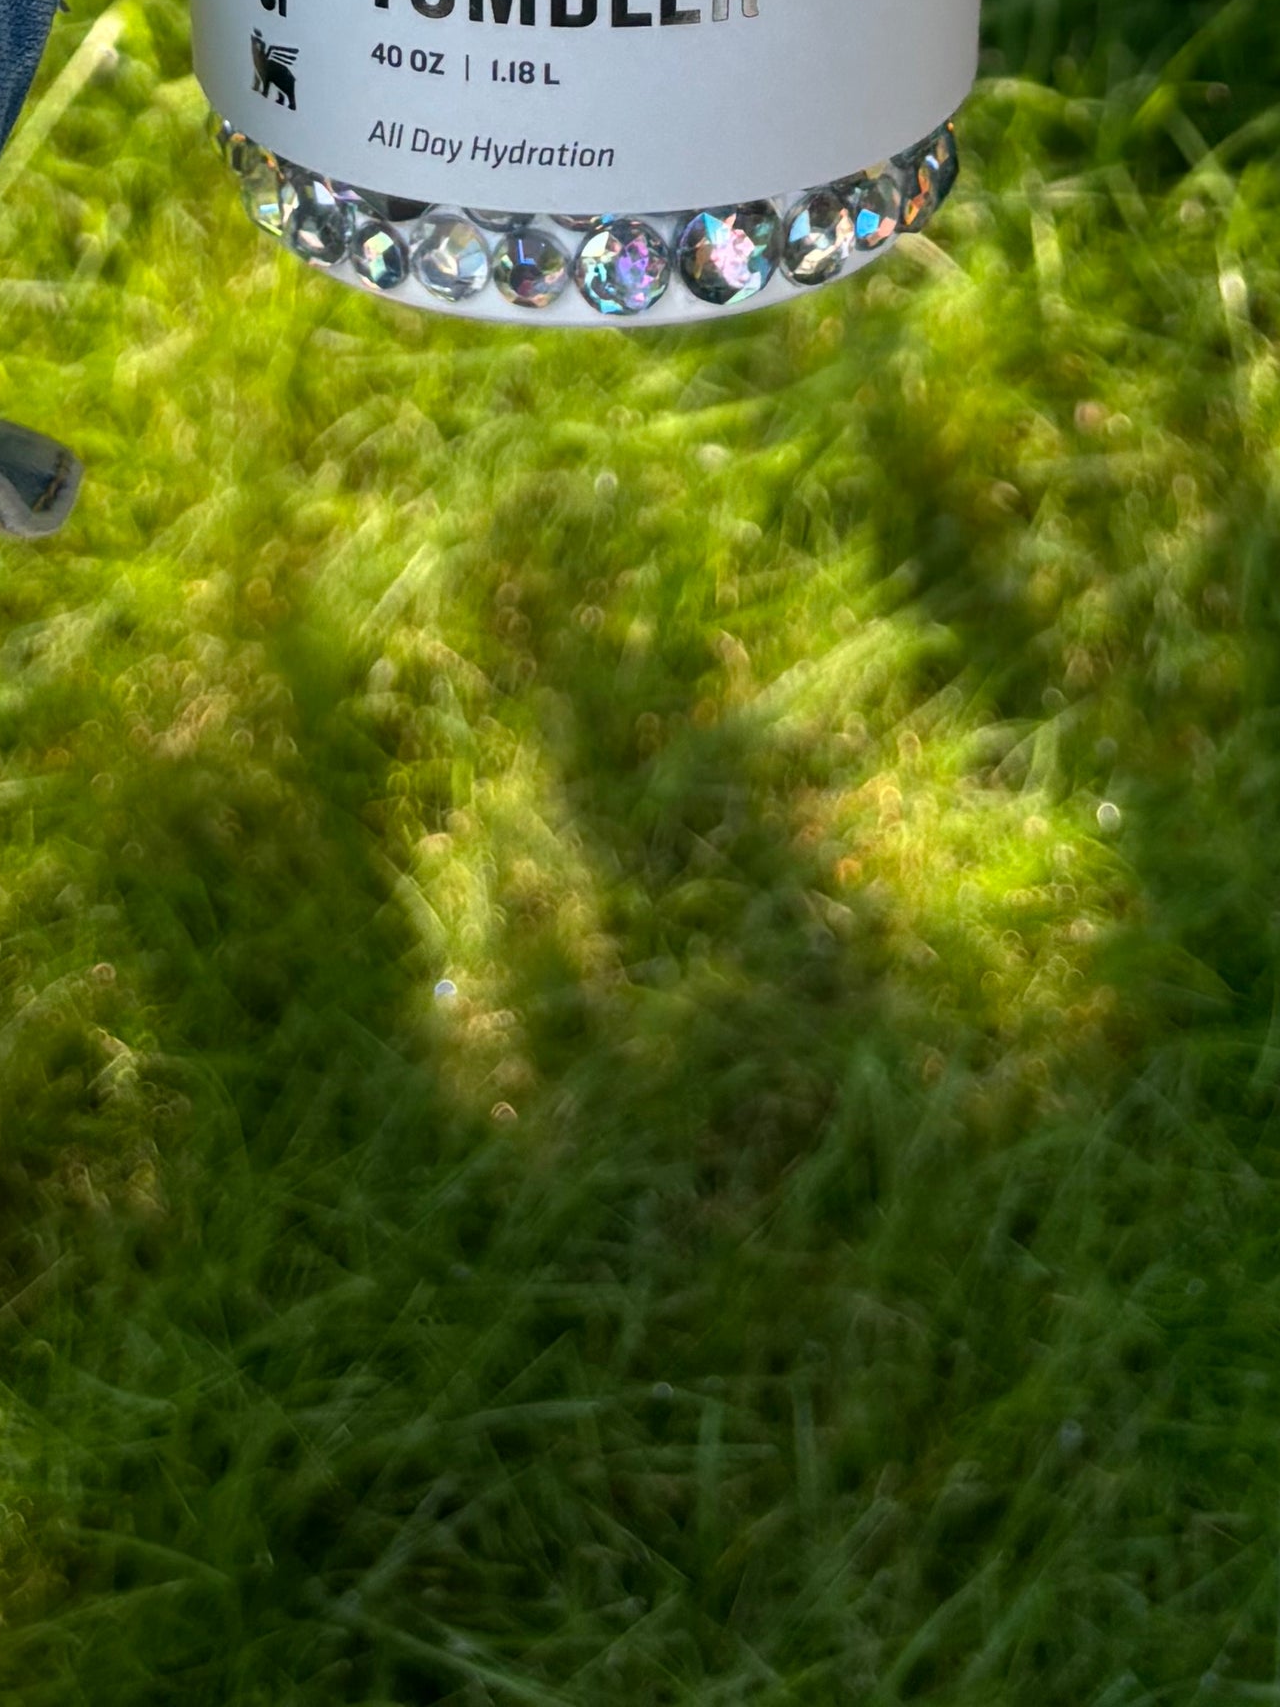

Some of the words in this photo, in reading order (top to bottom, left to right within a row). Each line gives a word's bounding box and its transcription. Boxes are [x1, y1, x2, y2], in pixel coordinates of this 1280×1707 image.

[371, 41, 403, 69] 40
[410, 46, 445, 77] OZ
[491, 60, 537, 86] 1.18
[543, 62, 560, 86] L
[369, 120, 402, 149] All
[410, 127, 462, 164] Day
[471, 133, 614, 169] Hydration
